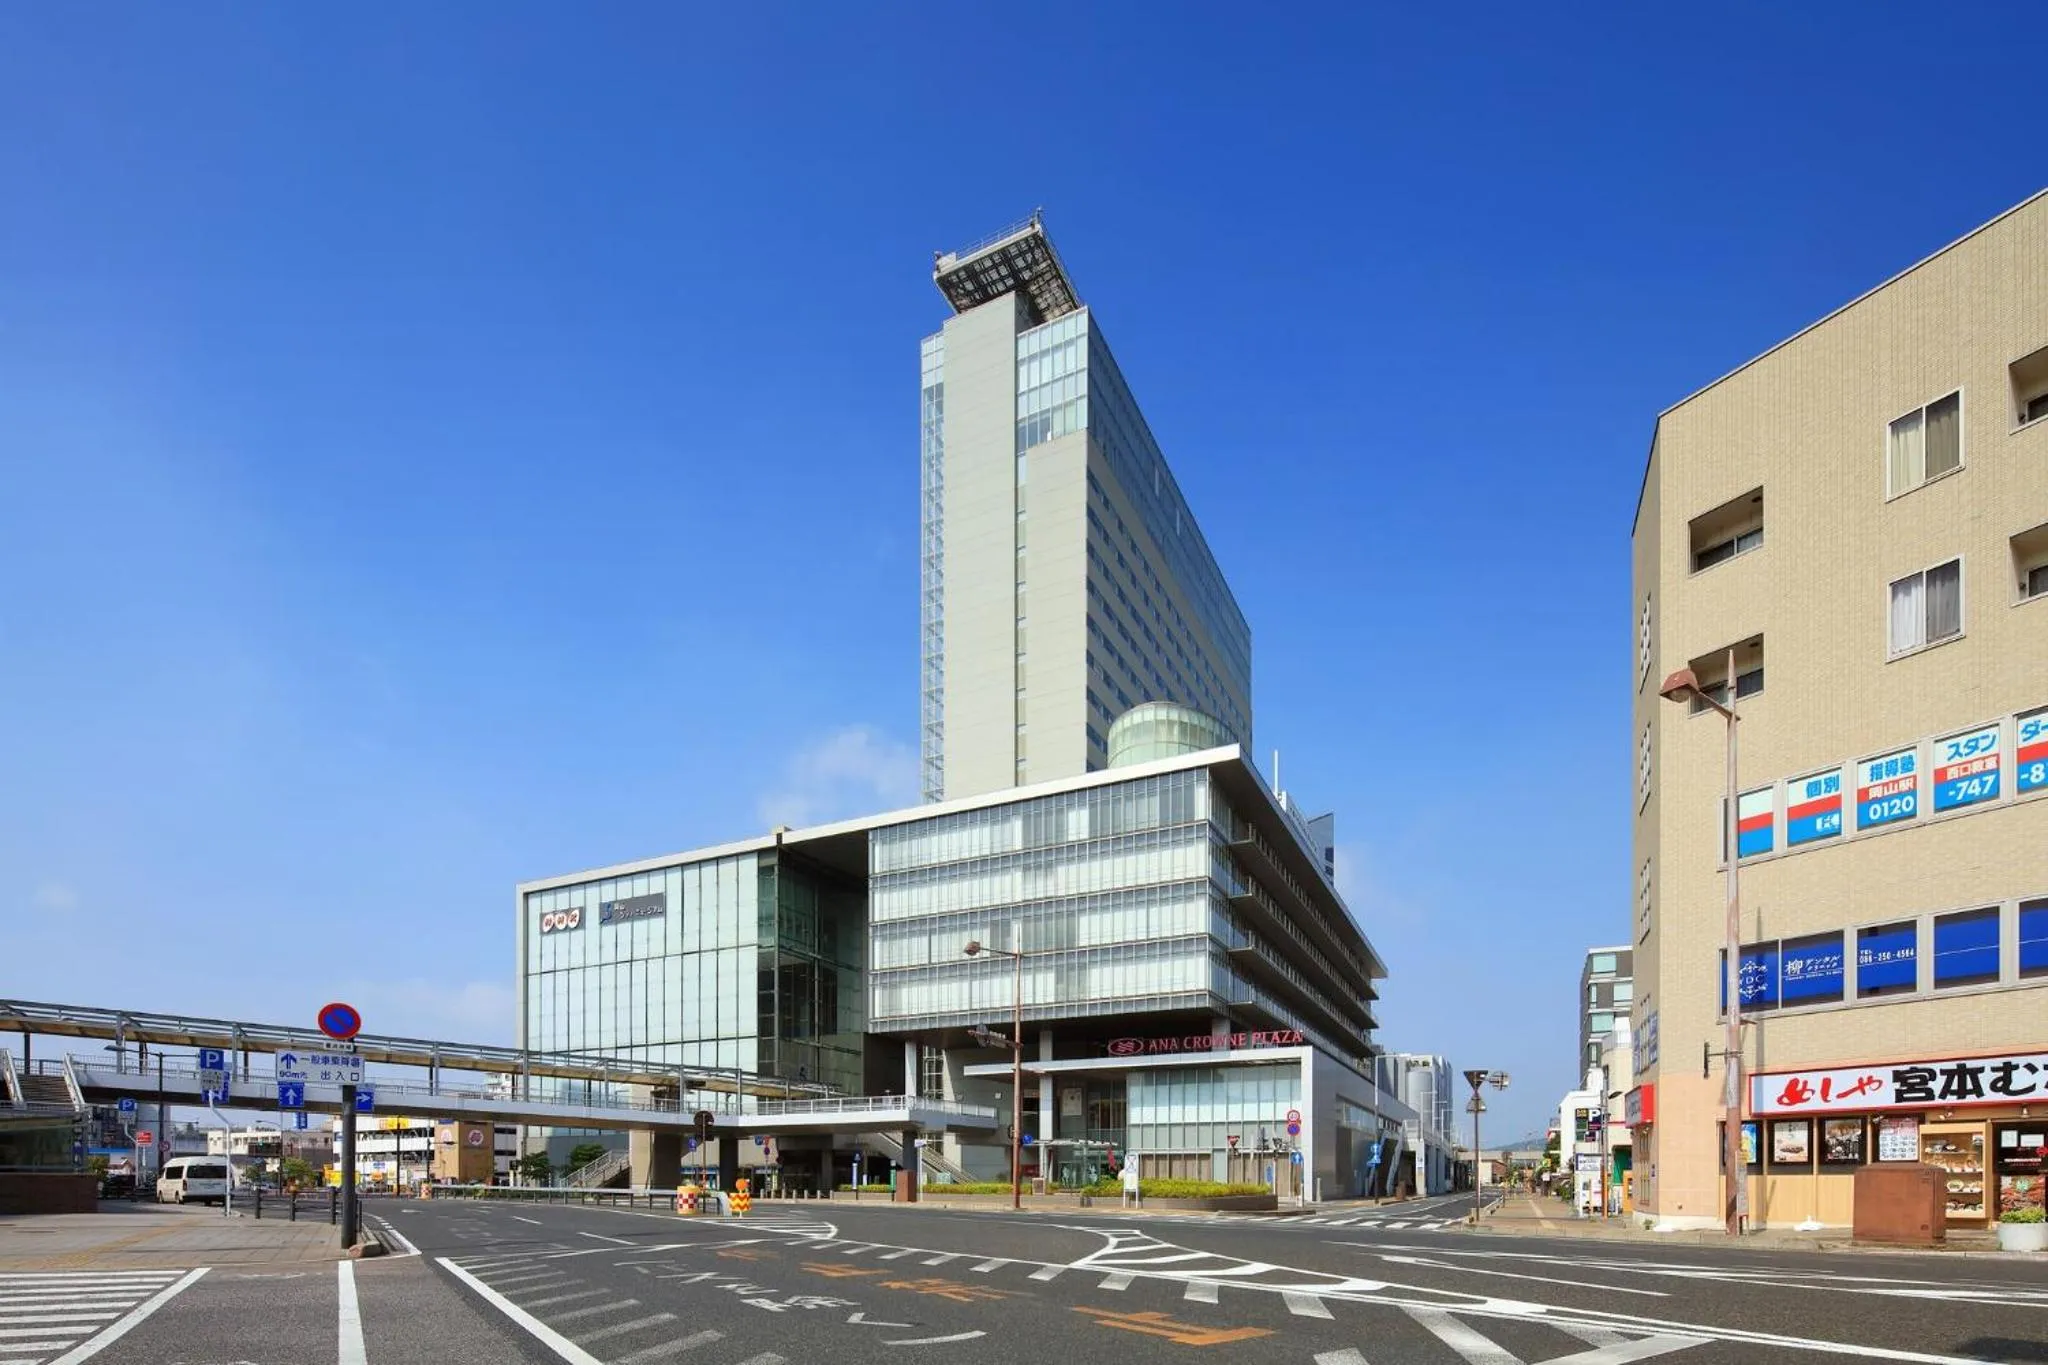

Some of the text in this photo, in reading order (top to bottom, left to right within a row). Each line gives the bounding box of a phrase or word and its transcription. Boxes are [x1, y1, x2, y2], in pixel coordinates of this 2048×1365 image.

[1806, 774, 1840, 799] 個別
[1869, 754, 1915, 782] 指導塾
[1947, 734, 1997, 761] スタン
[1868, 777, 1914, 801] 岡山駅
[1868, 796, 1915, 820] 0120
[1948, 774, 1996, 801] -747
[1149, 1030, 1303, 1051] ANA CROWNE PLAZA
[206, 1051, 220, 1068] P
[1891, 1060, 2048, 1104] 宮本む
[1588, 1109, 1601, 1122] P
